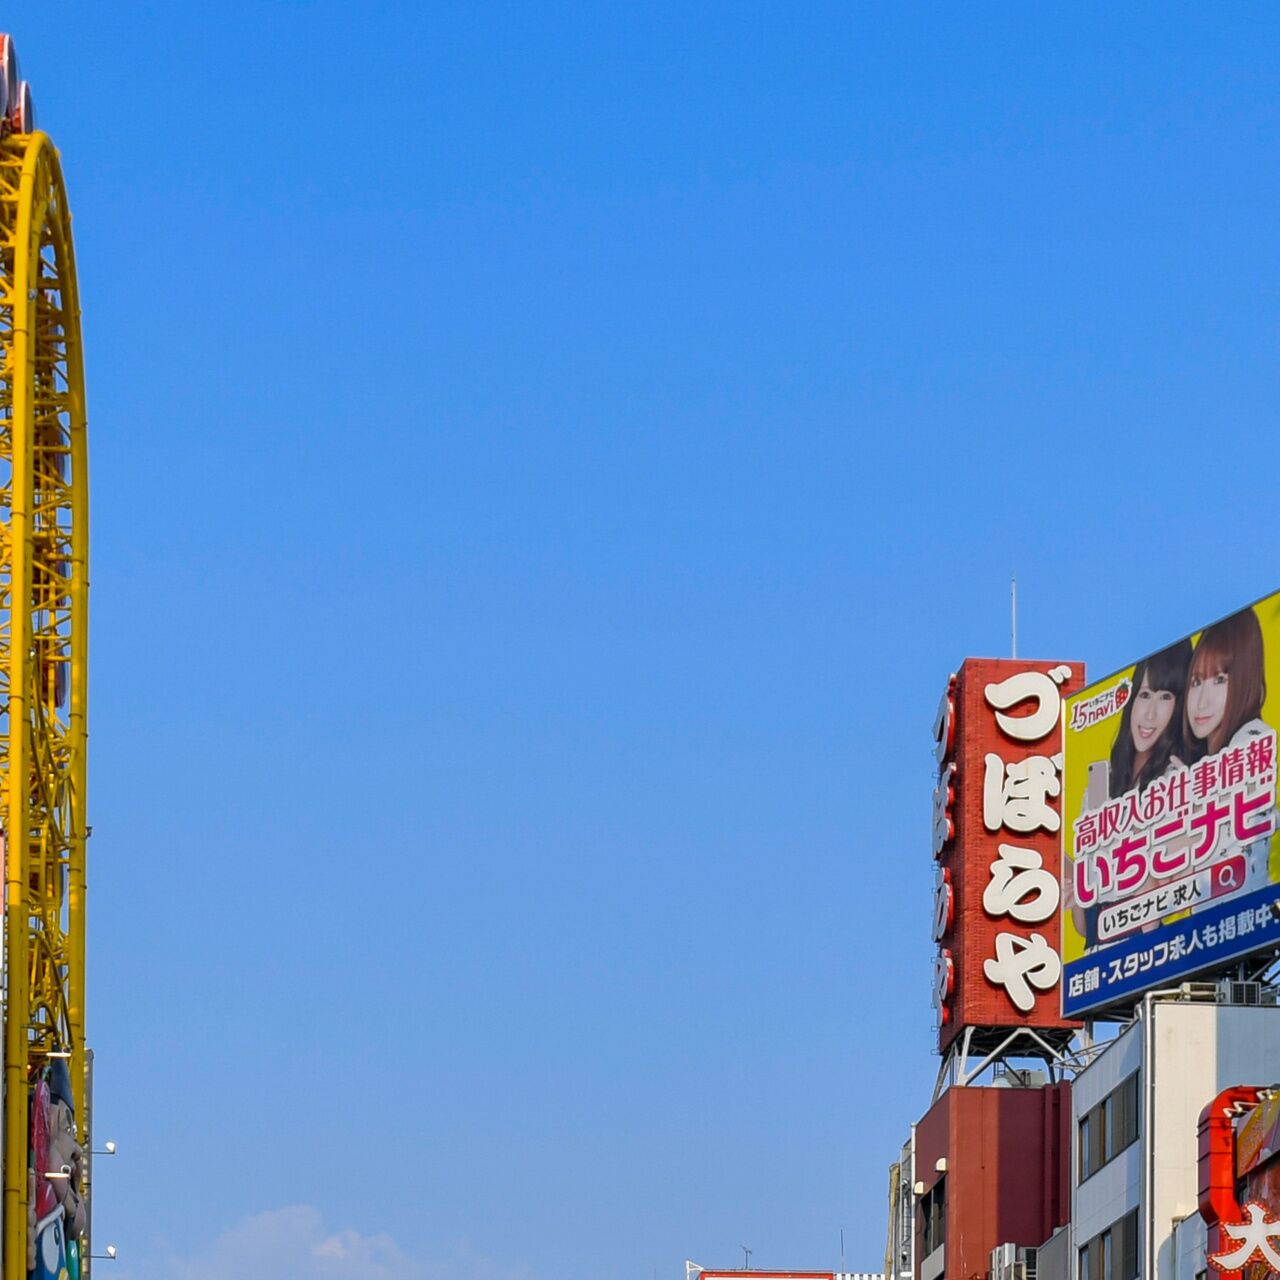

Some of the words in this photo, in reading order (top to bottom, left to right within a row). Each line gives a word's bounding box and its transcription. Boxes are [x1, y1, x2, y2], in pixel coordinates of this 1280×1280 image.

[985, 665, 1072, 1012] づぼらや
[1075, 735, 1273, 852] 高収入お仕事情報
[1075, 775, 1273, 905] いちごナビ
[1103, 889, 1168, 933] いちごナビ
[1173, 883, 1202, 908] 求人
